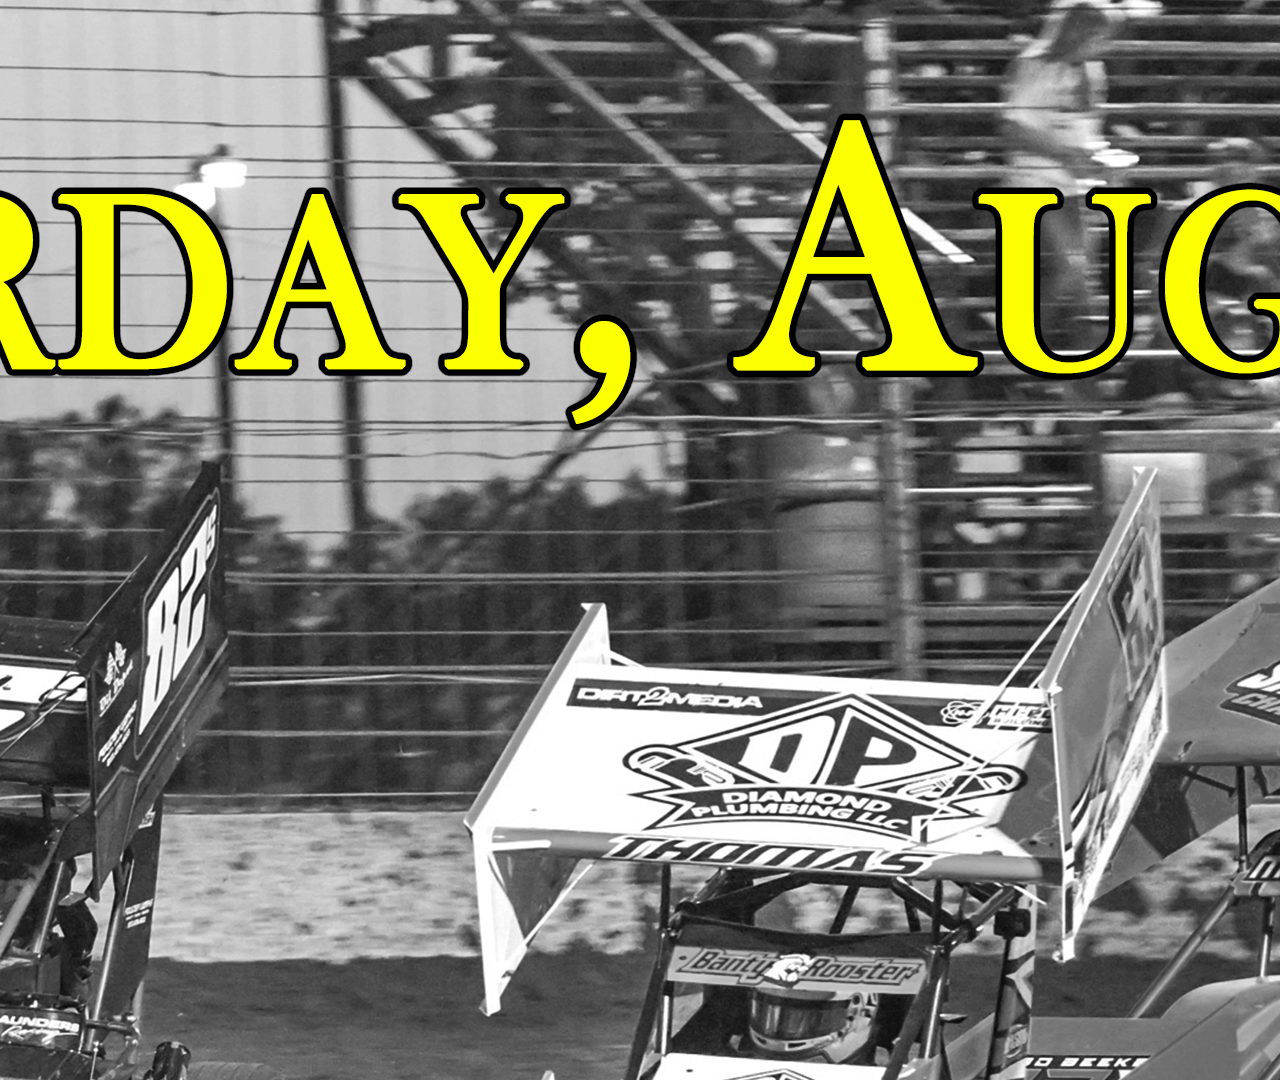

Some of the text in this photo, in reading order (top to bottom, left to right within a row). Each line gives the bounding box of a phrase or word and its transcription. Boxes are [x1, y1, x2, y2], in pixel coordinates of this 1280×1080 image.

[690, 803, 908, 829] PLUMBING LLC
[722, 790, 892, 812] DIAMOND
[608, 838, 937, 876] THOMAS
[686, 949, 926, 987] Banty Rooster
